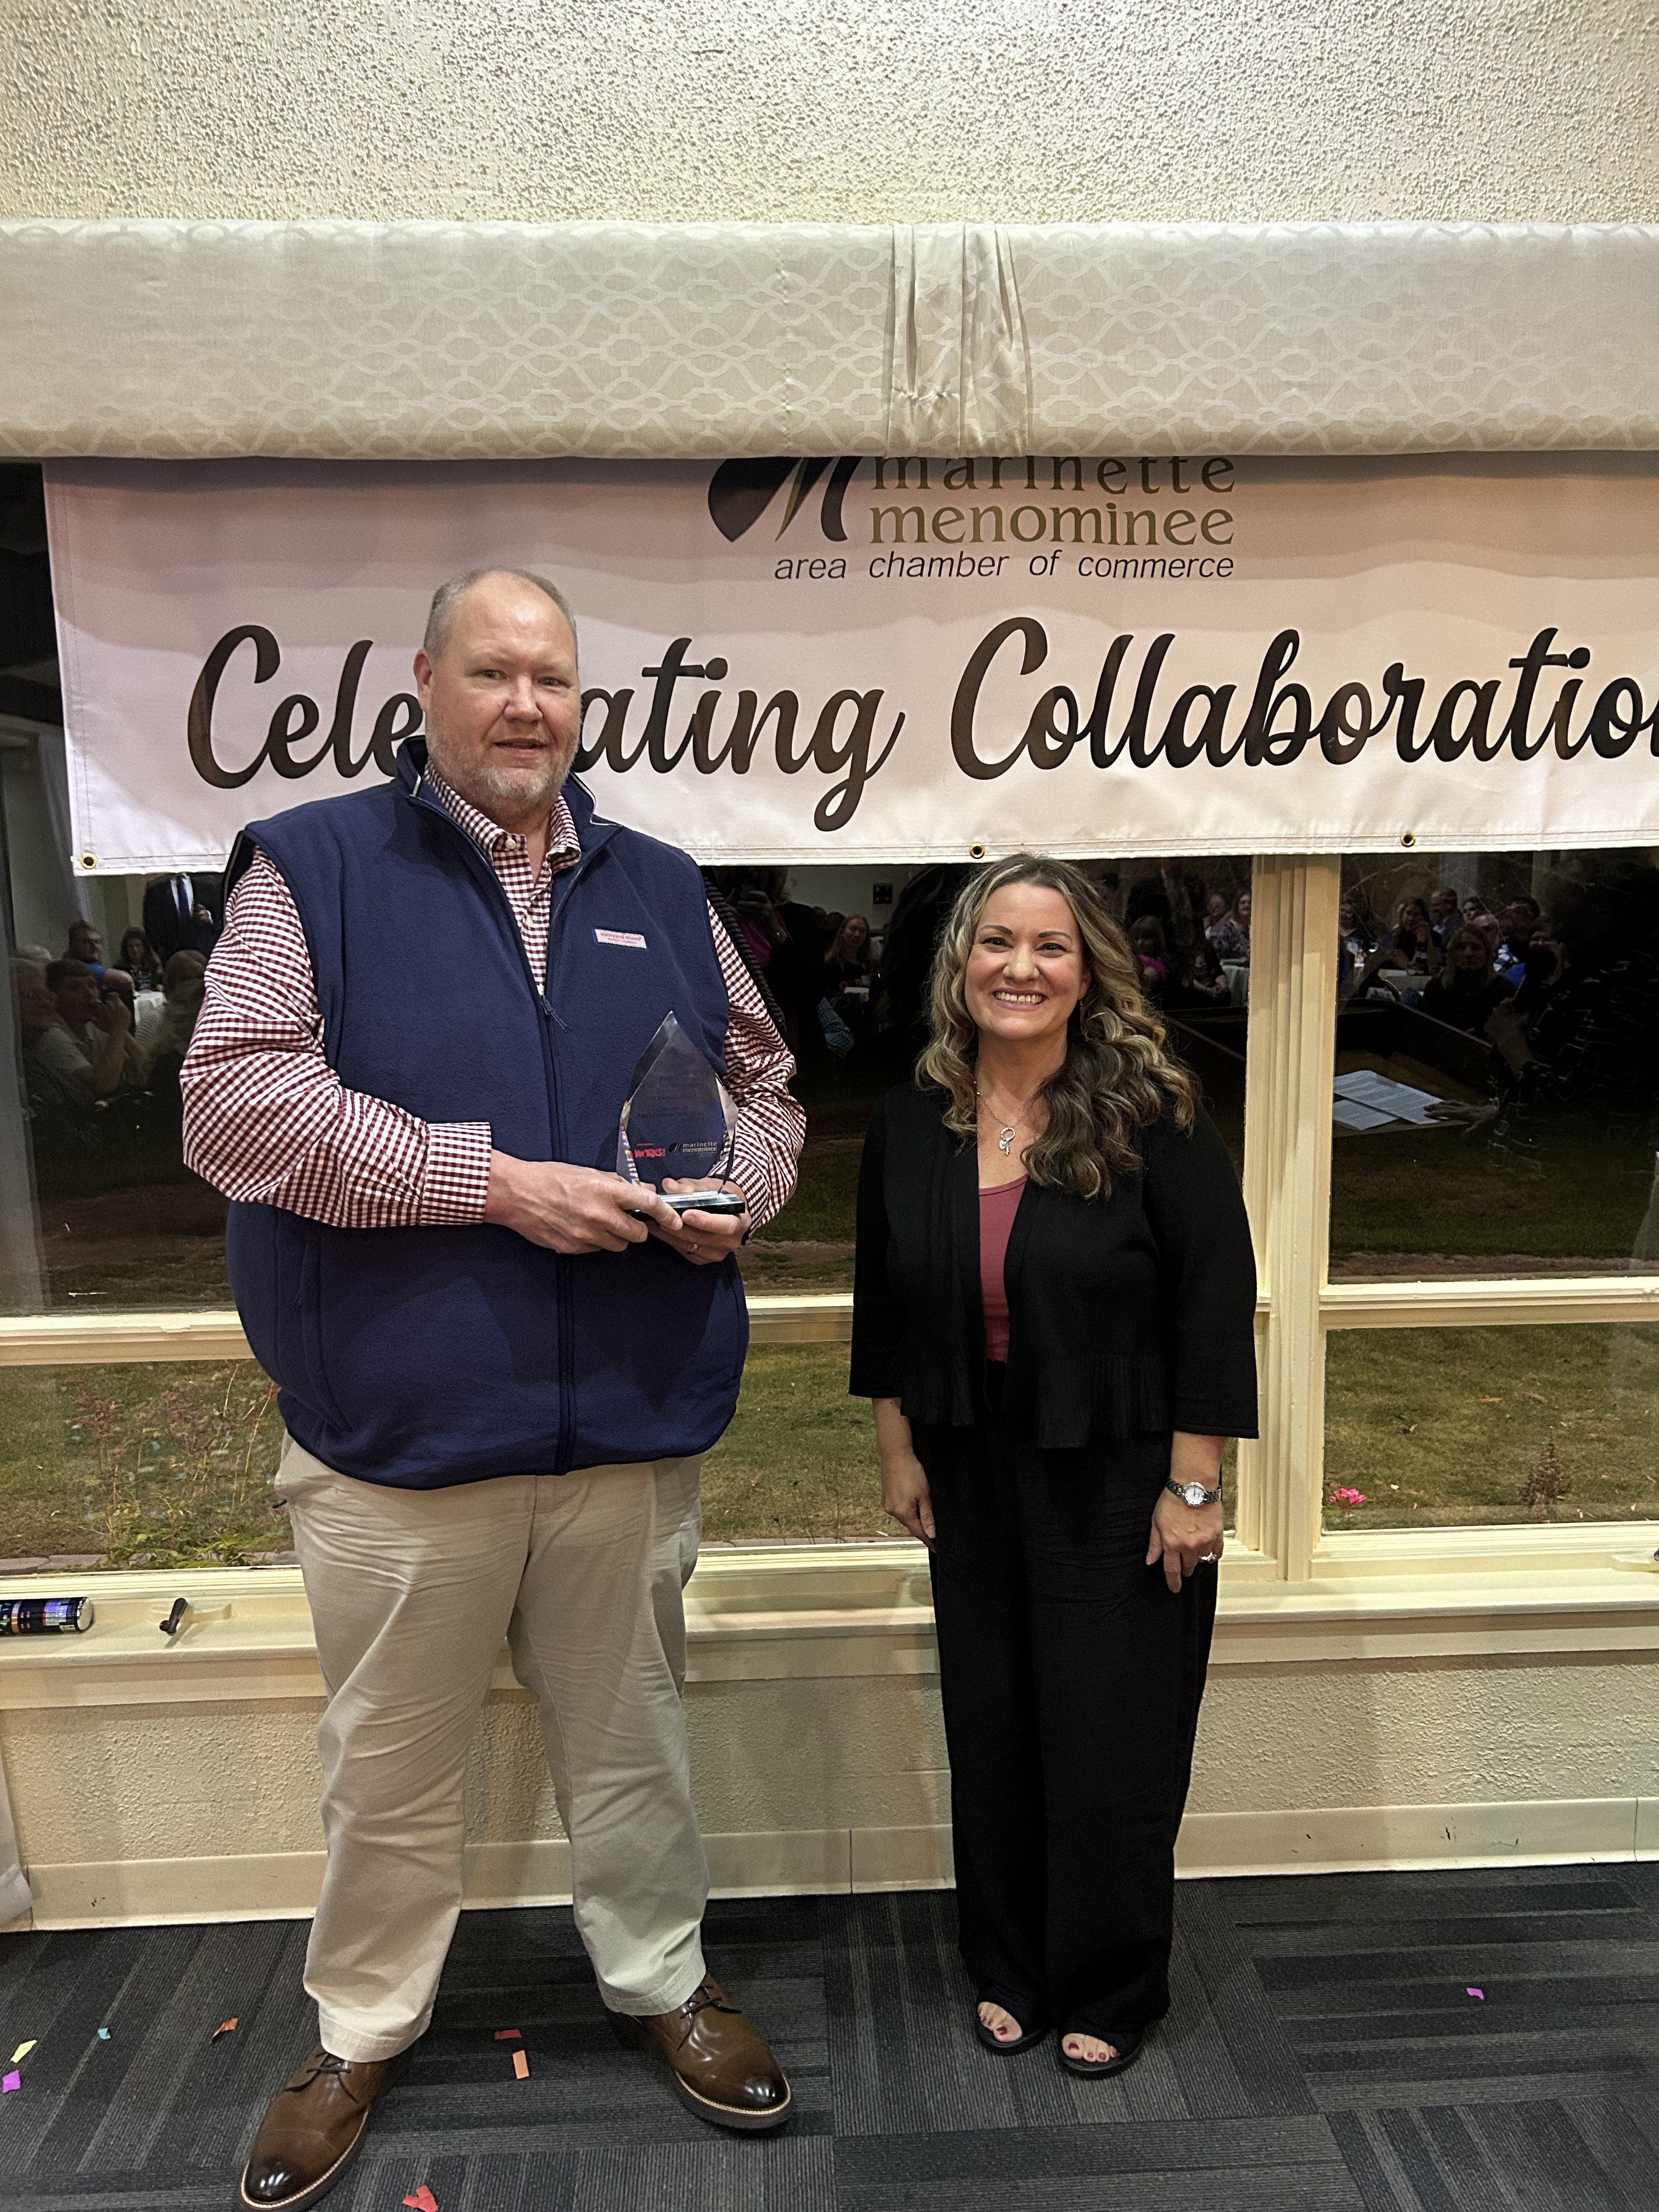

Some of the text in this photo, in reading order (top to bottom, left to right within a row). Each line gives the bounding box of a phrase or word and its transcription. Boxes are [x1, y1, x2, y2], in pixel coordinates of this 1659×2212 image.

[868, 501, 1235, 546] menominee
[774, 549, 1234, 579] area chamber of commerce
[187, 616, 1659, 832] Celeating Collaboratio
